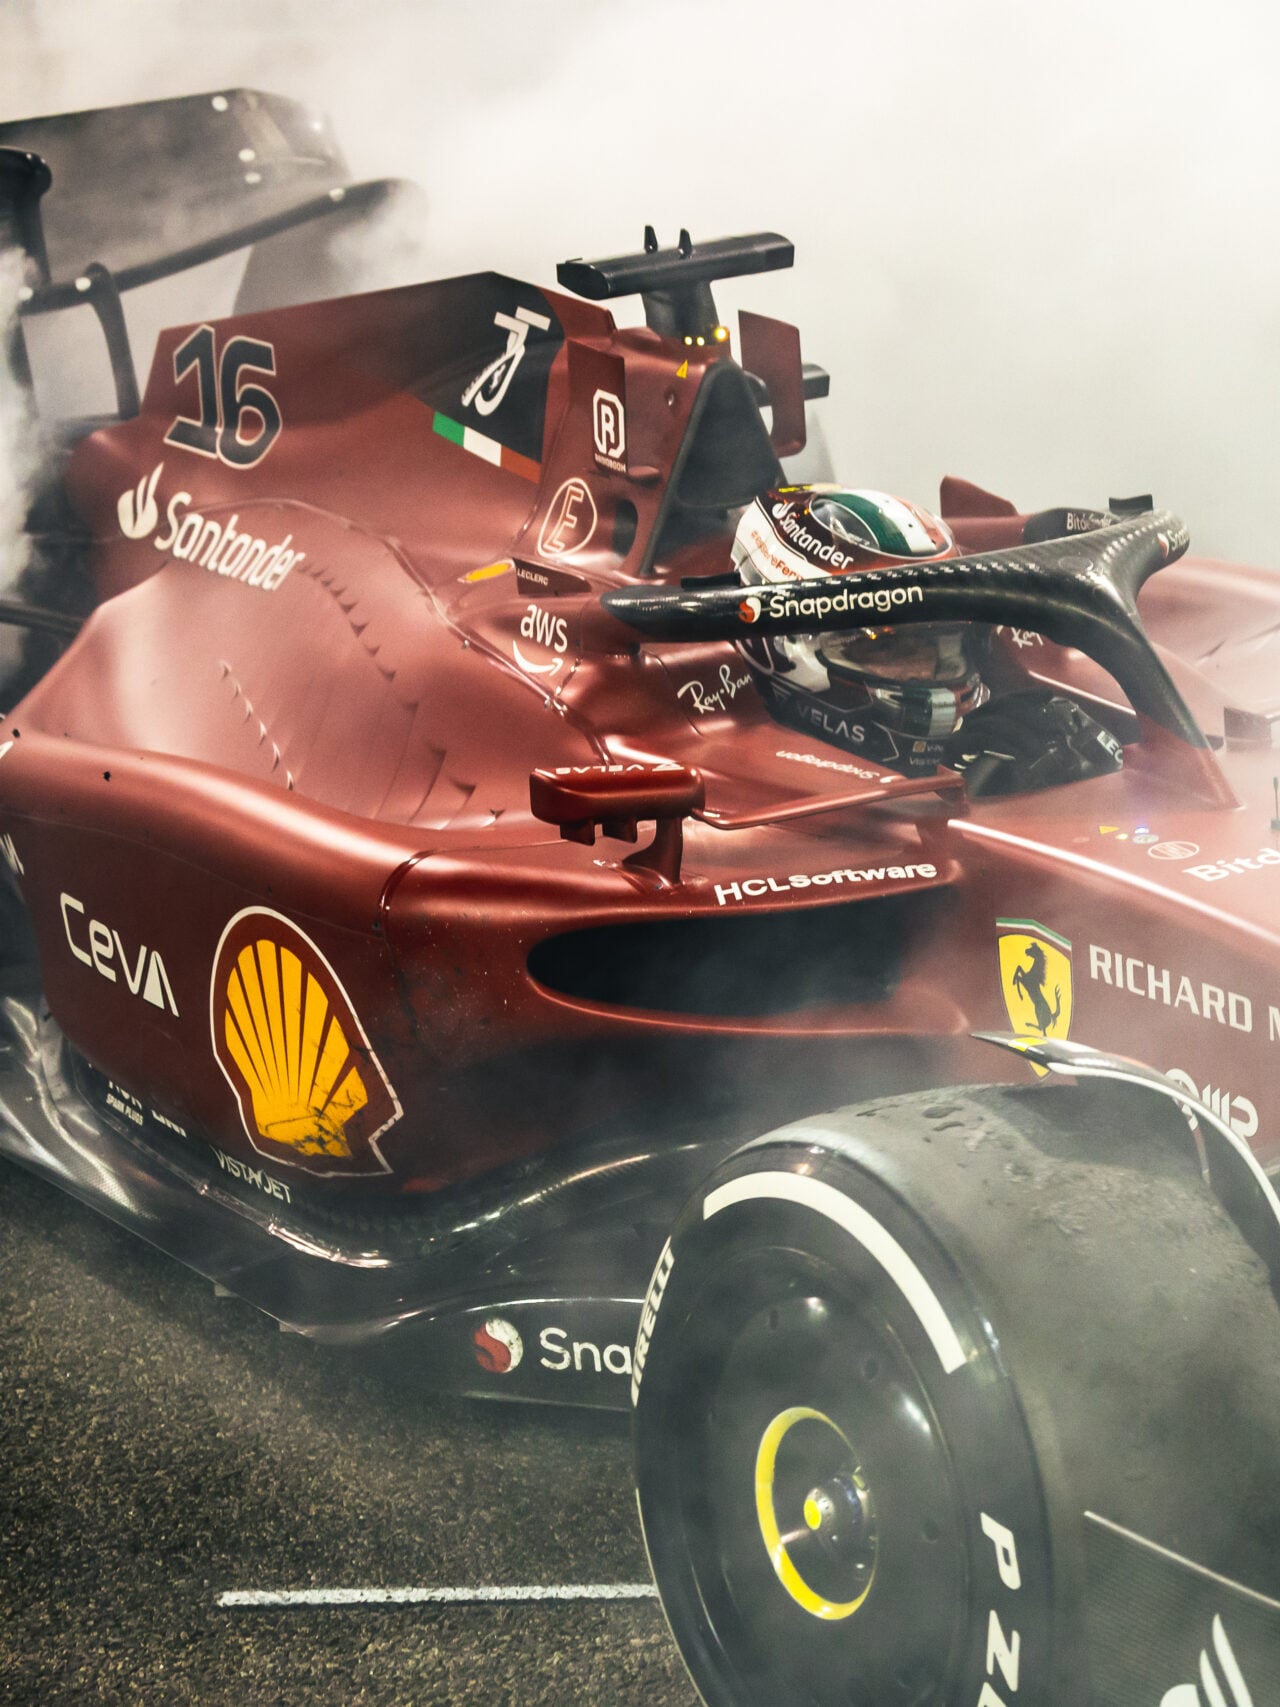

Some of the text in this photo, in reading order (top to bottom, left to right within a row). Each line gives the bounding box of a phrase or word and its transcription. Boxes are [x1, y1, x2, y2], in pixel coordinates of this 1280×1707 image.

[163, 324, 282, 469] 16
[154, 491, 306, 590] Santander
[779, 513, 854, 570] Santander
[517, 567, 549, 587] LECLERC
[770, 586, 924, 618] Snapdragon
[520, 604, 568, 653] aws
[798, 703, 866, 743] VELAS
[1097, 730, 1124, 770] LEC
[714, 863, 938, 906] HCLSoftware
[1089, 944, 1254, 1034] RICHARD
[631, 1235, 675, 1408] PIRELLI
[539, 1327, 633, 1375] Sna
[981, 1512, 1021, 1590] P
